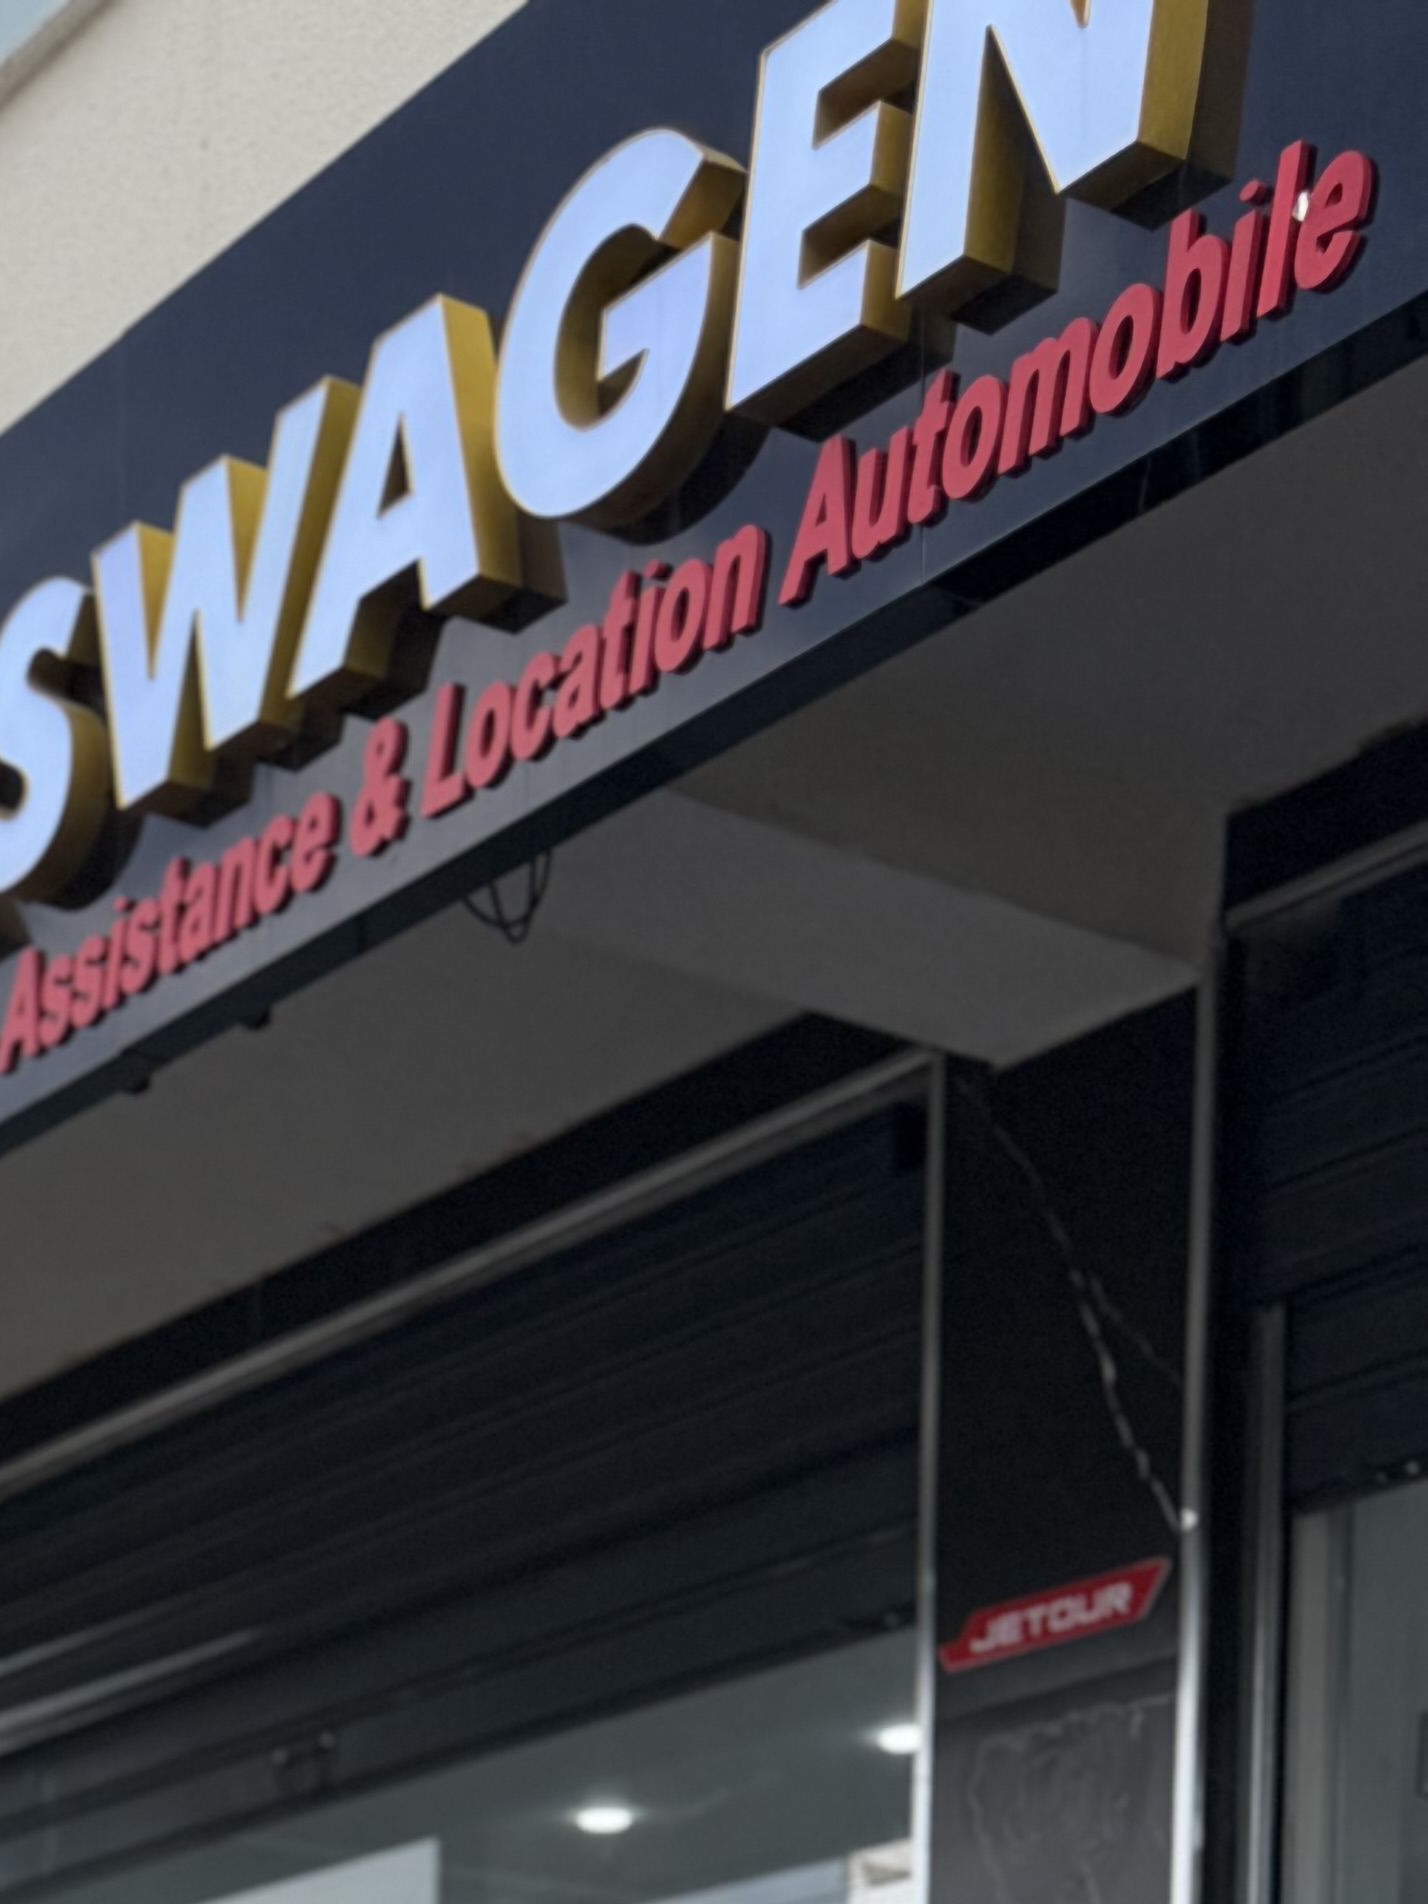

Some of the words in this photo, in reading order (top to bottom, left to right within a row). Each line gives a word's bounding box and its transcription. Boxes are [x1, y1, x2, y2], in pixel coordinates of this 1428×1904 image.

[350, 715, 407, 857] &
[420, 524, 765, 817] Location
[778, 139, 1372, 606] Automobile
[969, 1581, 1133, 1655] JETOUR
